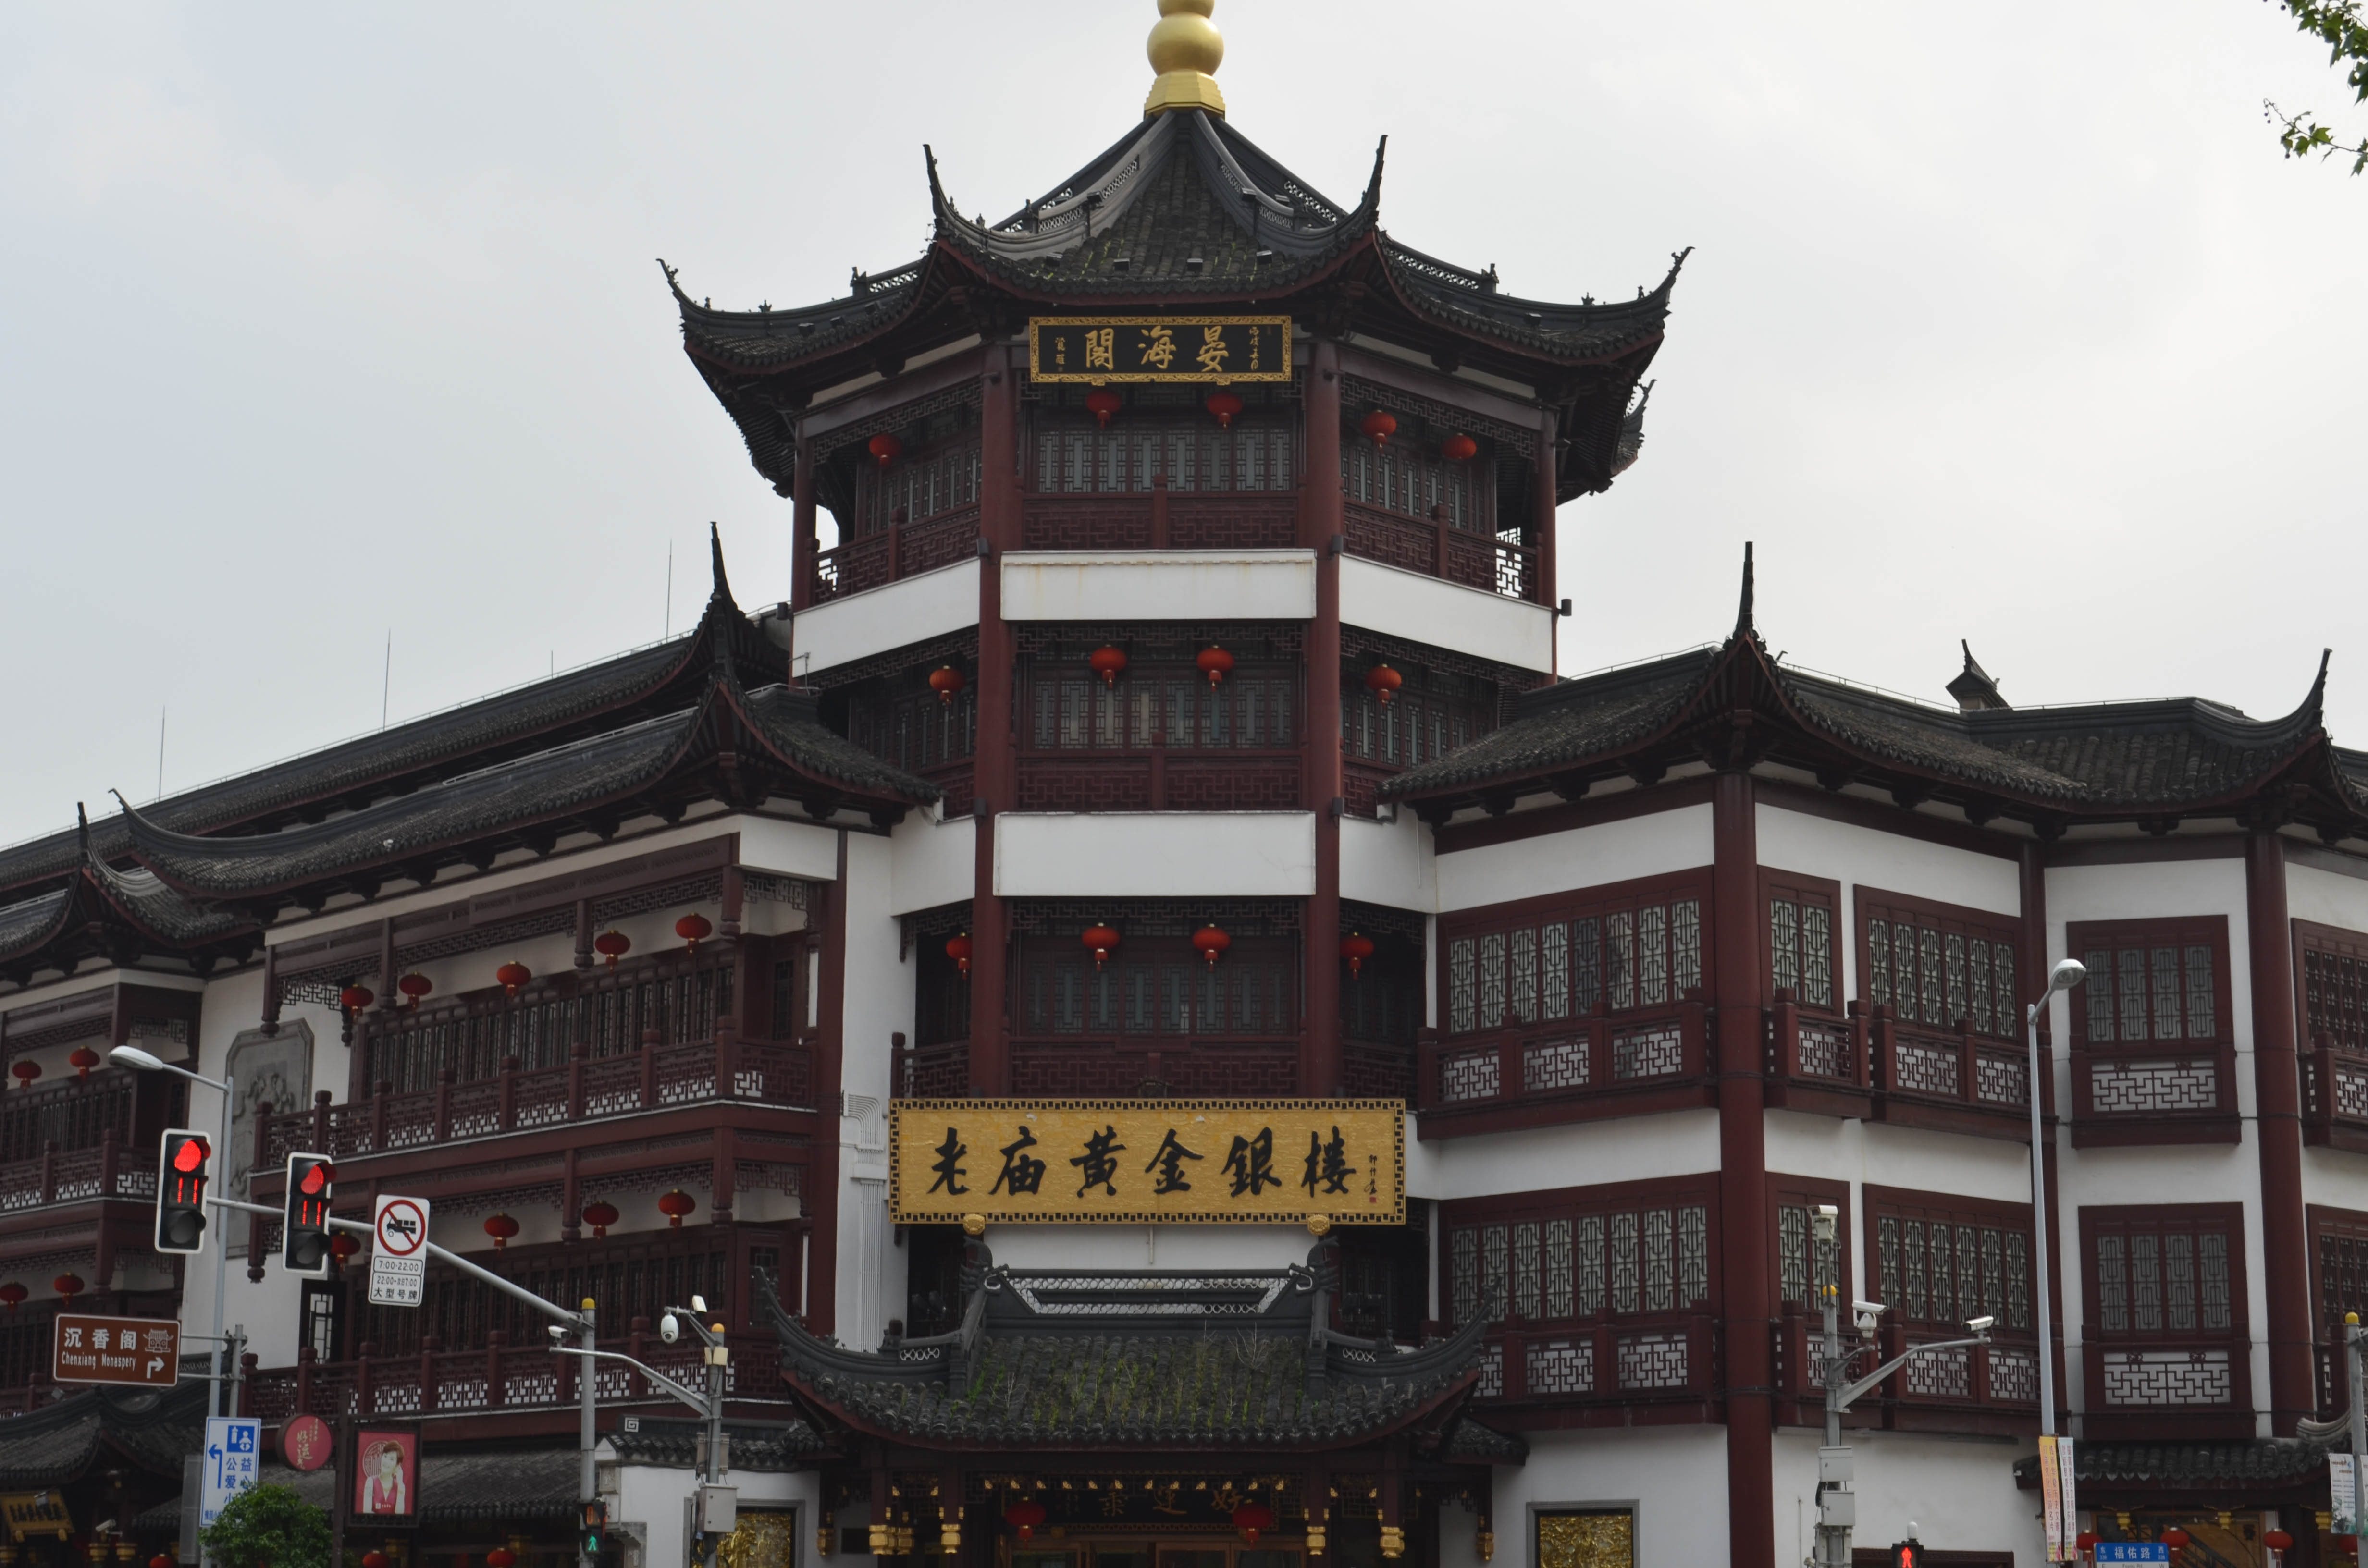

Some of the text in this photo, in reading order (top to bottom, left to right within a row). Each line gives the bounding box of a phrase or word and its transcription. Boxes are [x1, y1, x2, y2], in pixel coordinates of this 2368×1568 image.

[1085, 325, 1229, 373] 晏海閣
[379, 1261, 419, 1272] 7:00-22:00
[374, 1287, 417, 1300] 大型号牌
[64, 1327, 136, 1350] 沉香阁
[62, 1351, 136, 1371] Chenxiang Monaspery
[226, 1457, 252, 1472] 公益
[225, 1474, 252, 1490] 爱心
[2100, 1545, 2106, 1554] 东
[2115, 1546, 2151, 1559] 福佑路
[2158, 1546, 2165, 1554] 西
